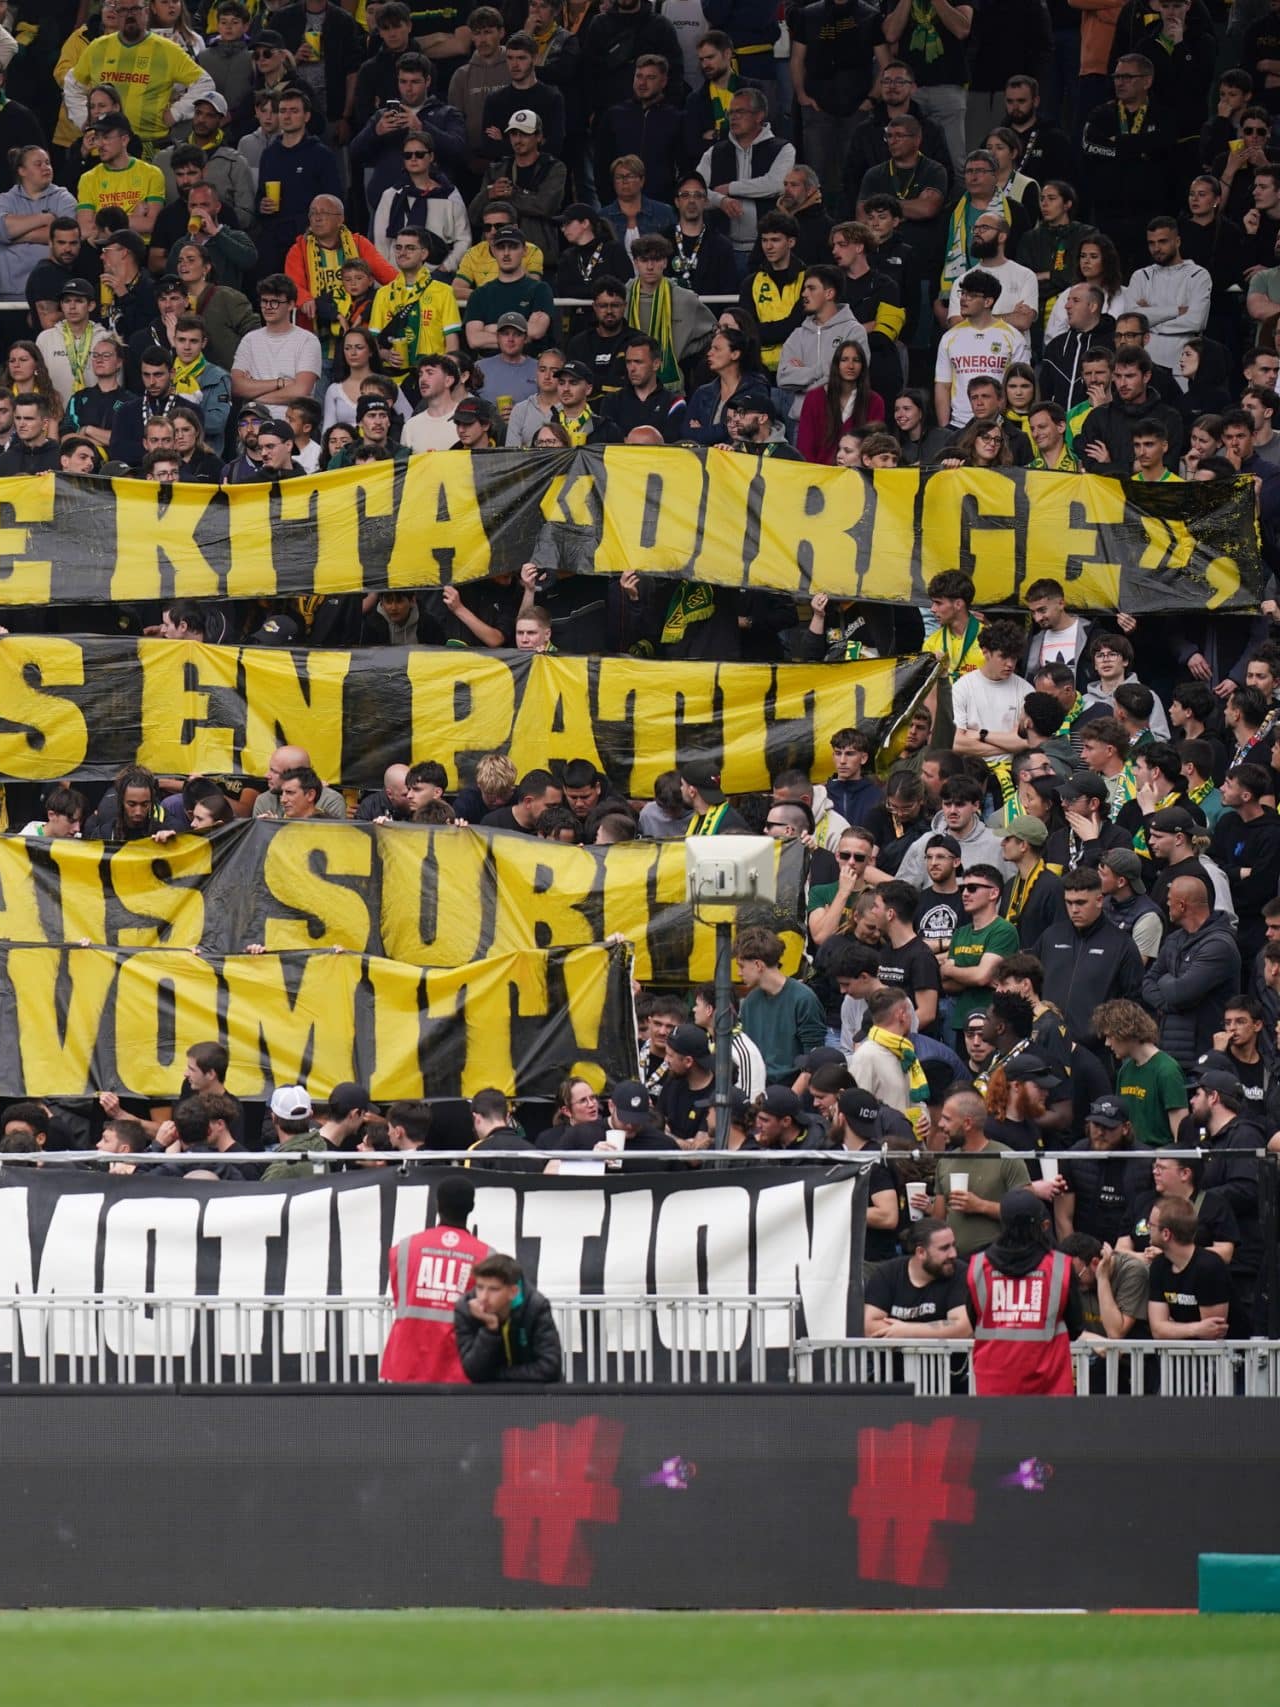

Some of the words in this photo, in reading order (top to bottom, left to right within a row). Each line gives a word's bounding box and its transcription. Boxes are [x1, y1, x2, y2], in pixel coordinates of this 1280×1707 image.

[99, 71, 150, 84] SYNERGIE
[98, 190, 142, 203] SYNERGIE
[951, 355, 1008, 369] SYNERGIE
[110, 450, 492, 600] KITA
[136, 638, 352, 785] EN
[406, 650, 898, 798] PATIT
[7, 945, 610, 1102] VOMIT!
[416, 1255, 457, 1291] ALL
[992, 1279, 1031, 1311] ALL
